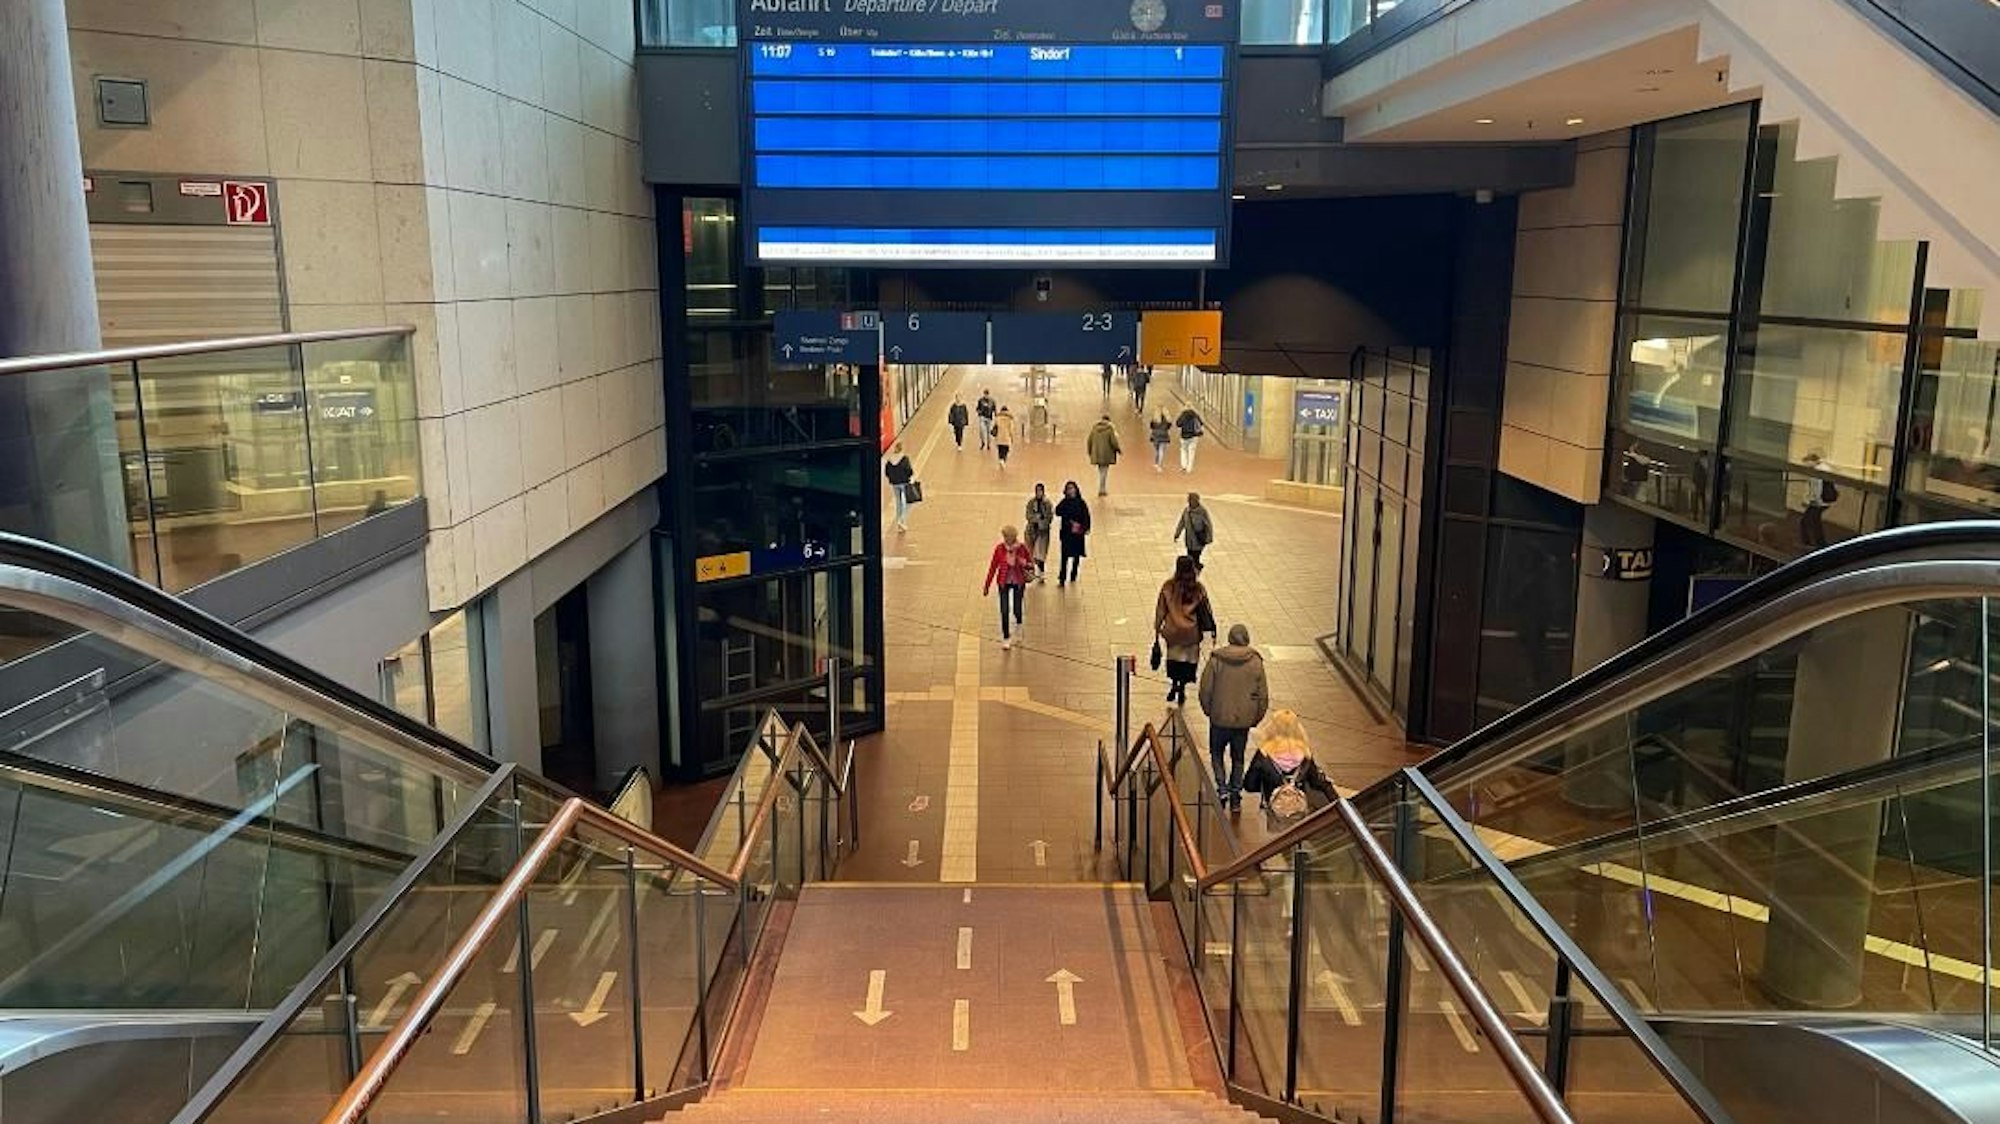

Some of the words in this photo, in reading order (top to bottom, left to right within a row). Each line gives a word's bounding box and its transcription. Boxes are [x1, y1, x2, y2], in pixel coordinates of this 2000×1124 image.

[844, 0, 927, 15] Departure
[760, 45, 792, 58] 11:07
[1174, 47, 1183, 61] 1
[908, 313, 920, 331] 6
[1082, 313, 1113, 331] 2-3
[803, 544, 813, 559] 6
